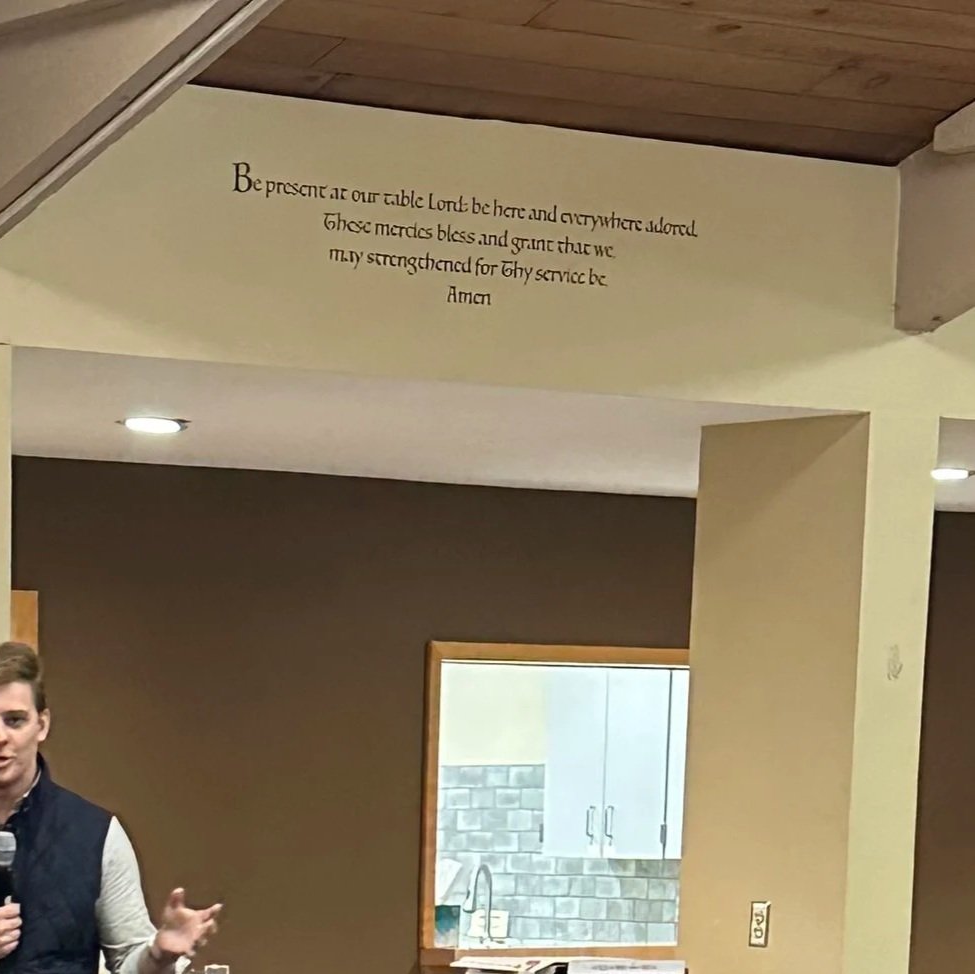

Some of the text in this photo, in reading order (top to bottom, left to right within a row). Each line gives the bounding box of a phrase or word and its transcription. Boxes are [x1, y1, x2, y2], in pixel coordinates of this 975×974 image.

[232, 161, 263, 193] Be
[266, 179, 328, 199] present
[329, 187, 349, 201] at
[351, 188, 380, 204] our
[383, 188, 425, 209] table
[471, 196, 491, 216] be
[493, 199, 526, 220] here
[528, 204, 558, 224] and
[560, 211, 643, 233] everywhere
[323, 211, 372, 234] These
[375, 221, 433, 241] mercies
[437, 223, 476, 245] bless
[478, 229, 509, 248] and
[511, 235, 554, 256] grant
[557, 236, 591, 256] that
[329, 247, 363, 270] may
[366, 251, 472, 276] strengthened
[475, 257, 499, 277] for
[501, 259, 533, 286] Thy
[535, 266, 586, 285] service
[446, 285, 492, 306] Amen
